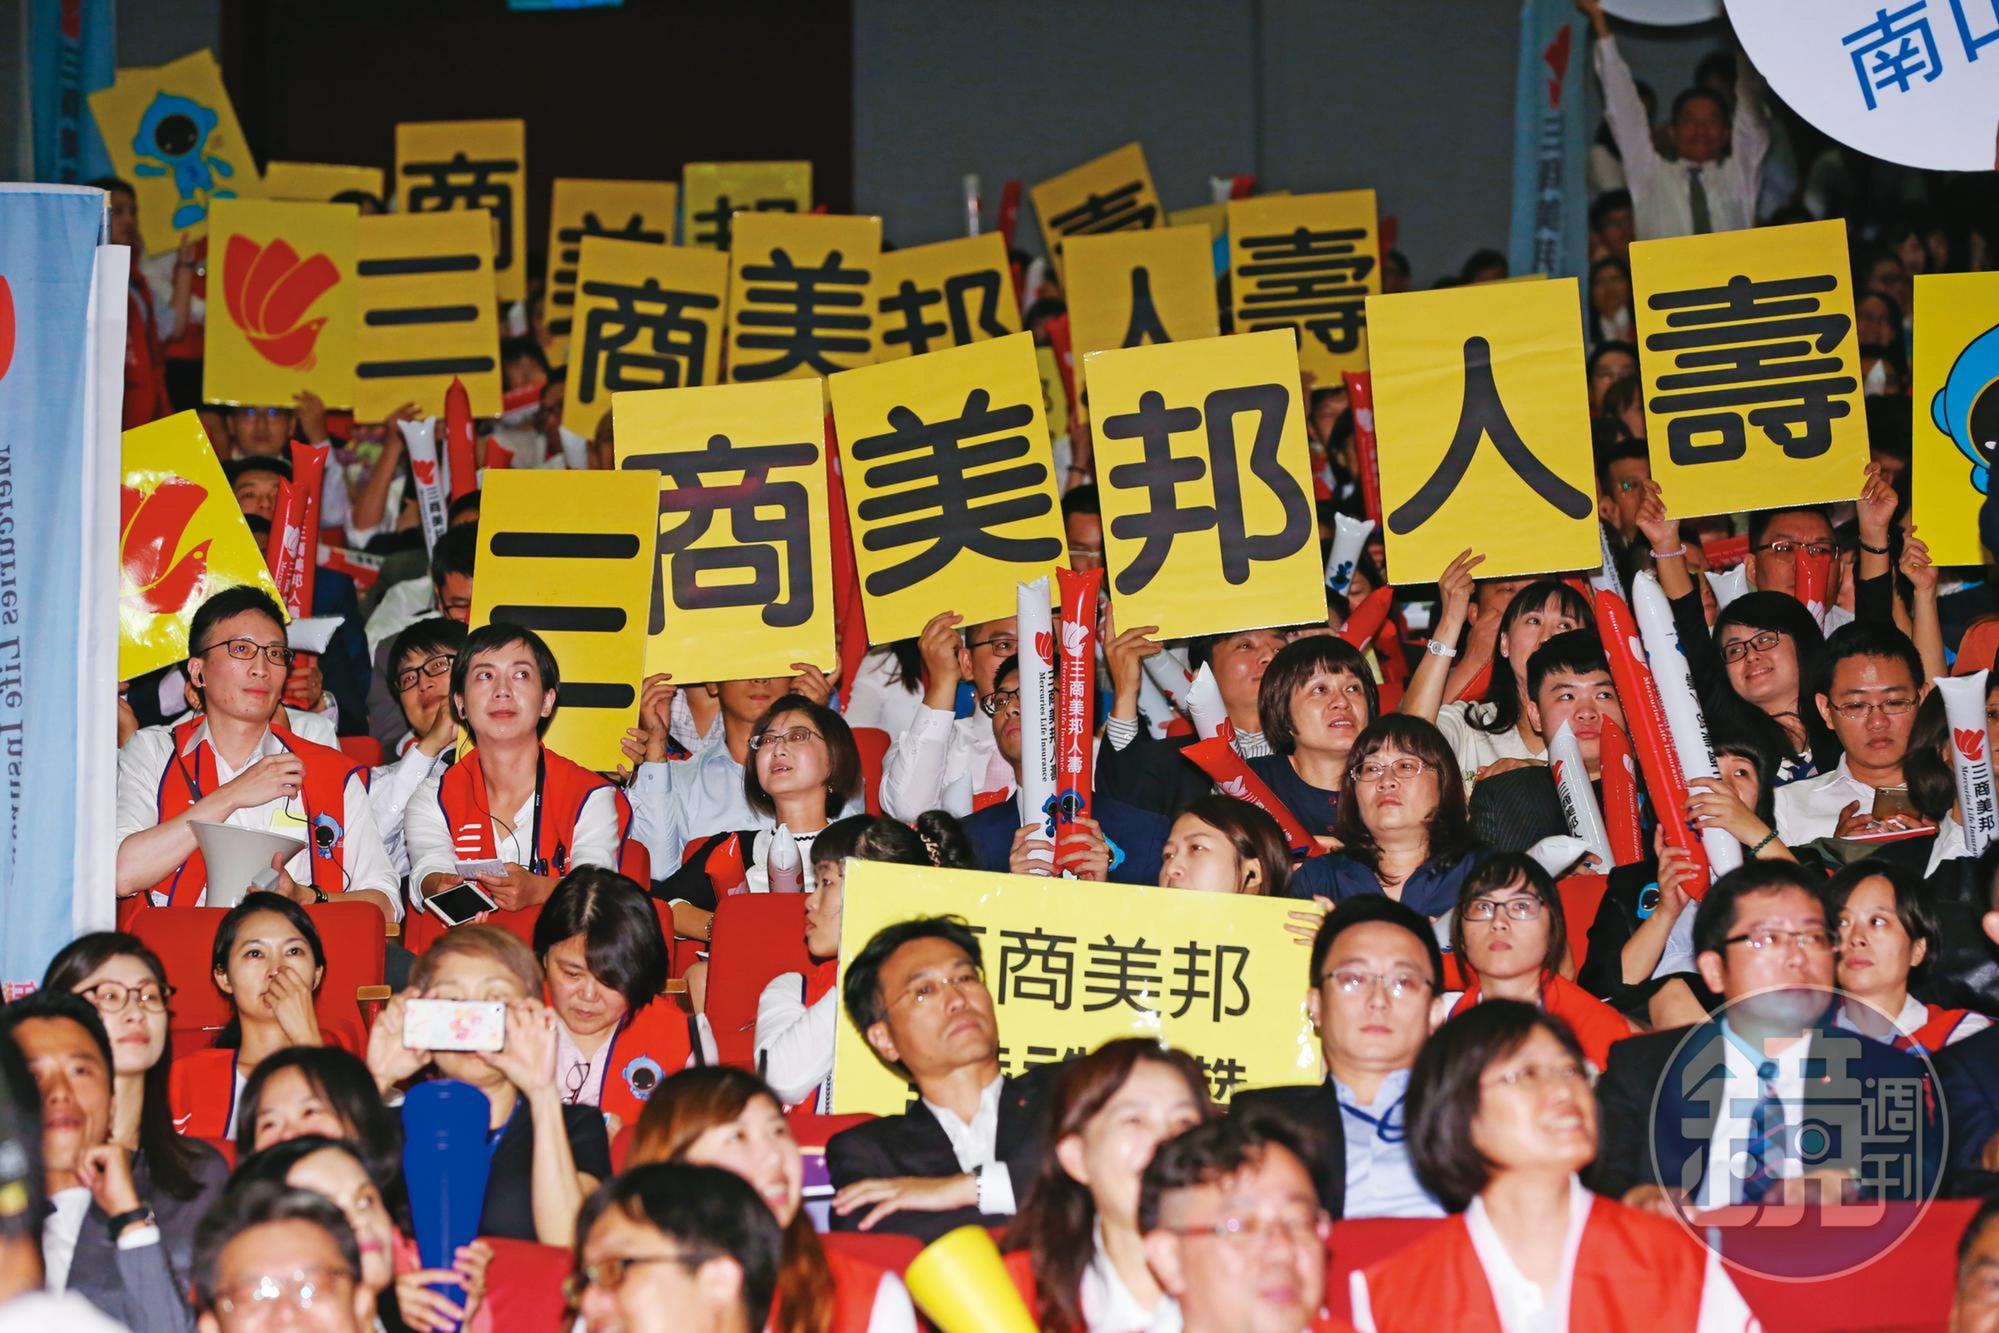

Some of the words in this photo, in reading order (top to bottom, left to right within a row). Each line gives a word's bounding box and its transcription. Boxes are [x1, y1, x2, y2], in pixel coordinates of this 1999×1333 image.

[356, 255, 495, 378] 三
[579, 278, 720, 404] 商
[733, 248, 872, 381] 美
[879, 270, 1013, 355] 邦
[1238, 228, 1375, 353] 壽
[1646, 274, 1857, 466] 壽
[852, 389, 1062, 597] 美
[1103, 383, 1312, 596] 邦
[1388, 336, 1593, 536] 人
[622, 435, 819, 636] 商
[490, 532, 640, 708] 三
[1039, 672, 1047, 717] Mercuries
[1068, 661, 1085, 773] 三商美邦人壽
[1643, 676, 1660, 721] Mercuries
[1657, 723, 1667, 742] Life
[1664, 744, 1682, 791] Insurance
[1040, 738, 1048, 782] Insurance
[966, 925, 1250, 1023] 商美邦
